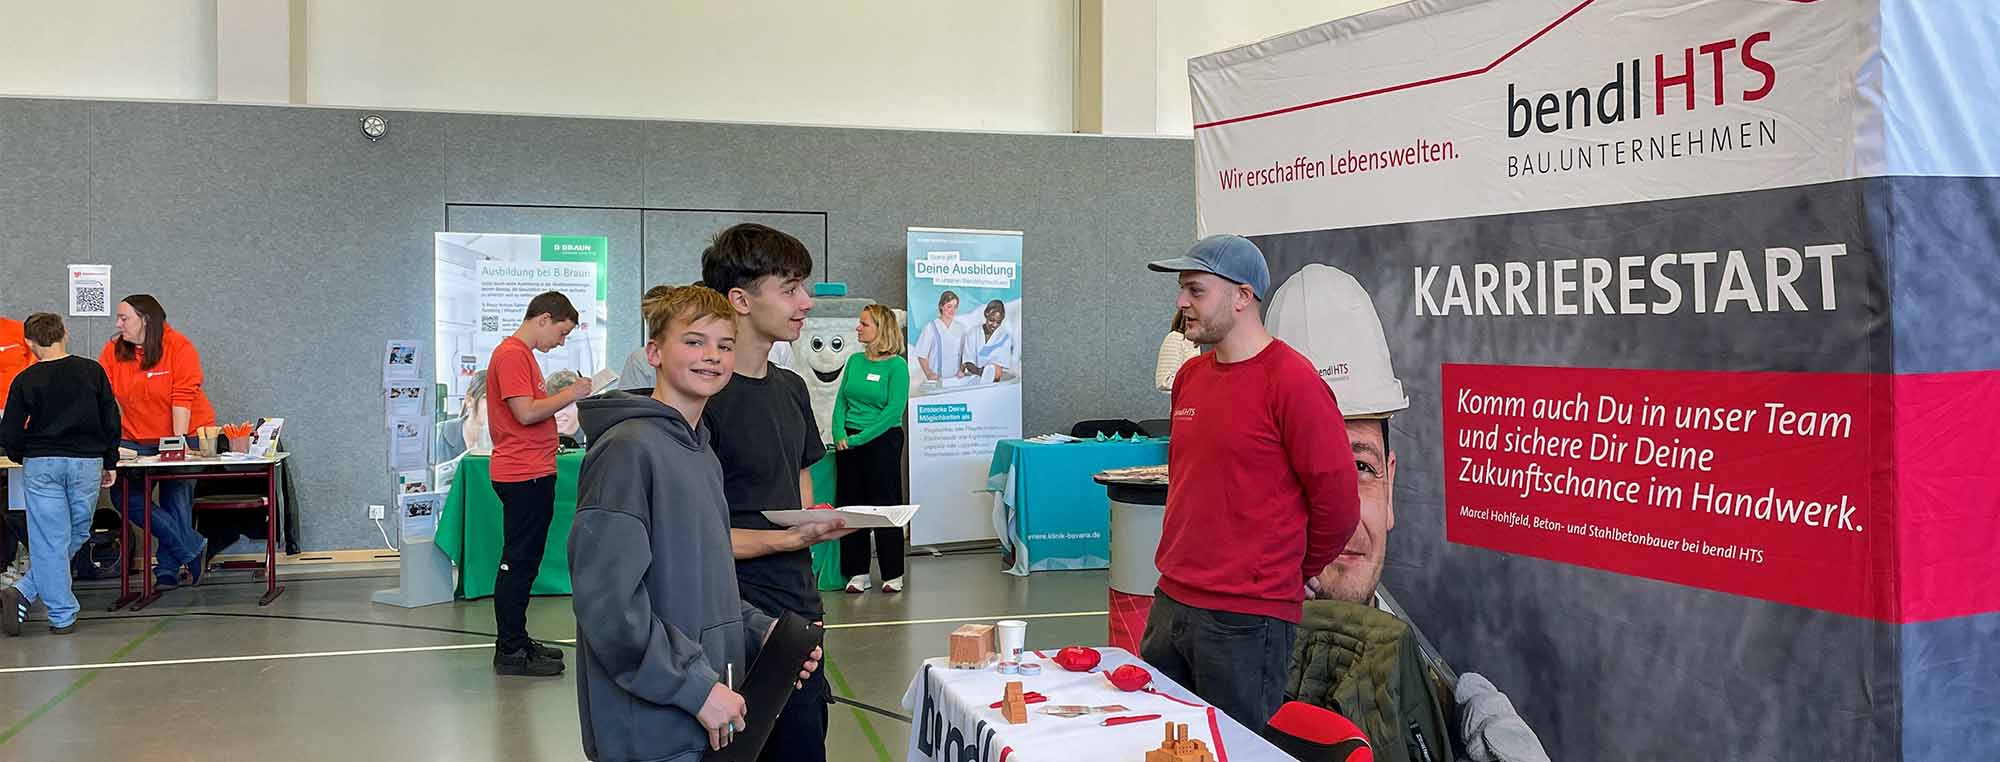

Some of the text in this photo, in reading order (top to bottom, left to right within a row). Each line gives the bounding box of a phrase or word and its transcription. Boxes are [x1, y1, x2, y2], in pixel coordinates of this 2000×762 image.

[1219, 138, 1460, 191] Wir erschaffen Lebenswelten.
[1508, 119, 1777, 178] BAU.UNTERNEHMEN
[482, 266, 534, 278] Ausbildung
[537, 267, 551, 277] bei
[563, 267, 591, 277] Braun
[917, 263, 1014, 278] Deine Ausbildung
[1414, 242, 1848, 317] KARRIERESTART
[1457, 388, 1852, 438] Komm auch Du in unser Team
[1459, 423, 1714, 471] und sichere Dir Deine
[1458, 457, 1863, 532] Zukunftschance im Handwerk.
[1460, 505, 1764, 563] Marcel Hohlfeld, Beton- und Stahlbetonbauer bei bendl HTS
